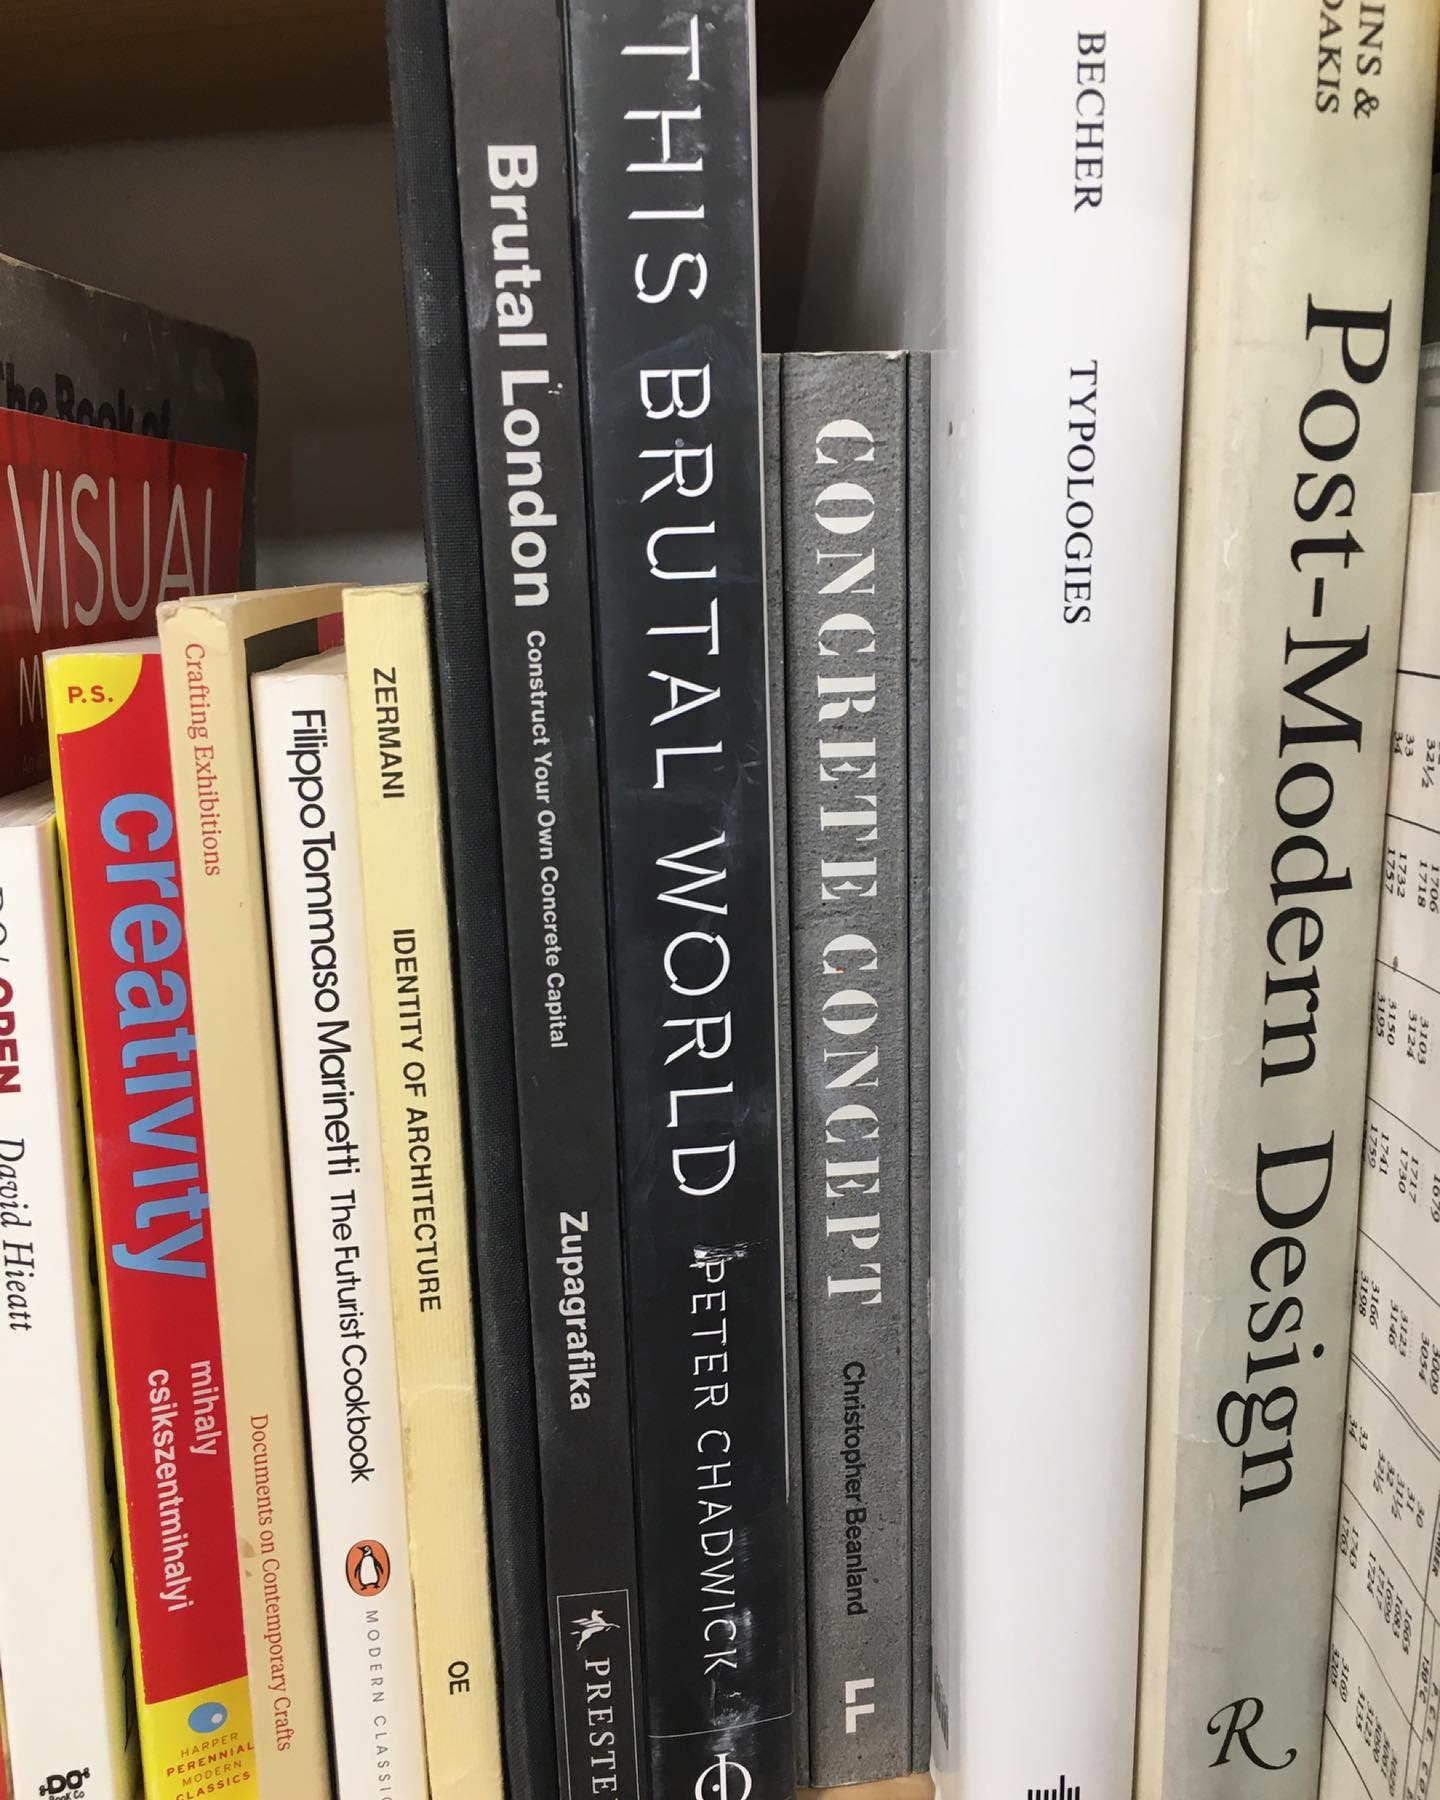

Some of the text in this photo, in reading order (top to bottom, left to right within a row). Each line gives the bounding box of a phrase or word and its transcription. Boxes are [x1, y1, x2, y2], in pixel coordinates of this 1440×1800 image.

[1354, 86, 1379, 120] &
[1063, 31, 1106, 625] BECHER TYPOLOGIES
[487, 145, 558, 607] Brutal London
[621, 14, 736, 1196] THIS BRUTAL WORLD
[68, 685, 114, 703] P.S.
[373, 667, 405, 799] ZERMANI
[1405, 734, 1415, 757] 33
[185, 643, 221, 877] Crafting Exhibitions
[526, 630, 569, 1049] Construct Your Own Concrete Capital
[815, 419, 882, 1305] CONCRETE CONCEPT
[1385, 848, 1396, 894] 1757
[1397, 852, 1407, 898] 1732
[1417, 860, 1428, 908] 1718
[1430, 864, 1440, 914] 1706
[1217, 293, 1392, 1513] Post-Modern Design
[286, 709, 360, 1176] Filippo Tommaso Marinetti
[100, 792, 210, 1279] creativity
[1375, 991, 1386, 1038] 3195
[1387, 997, 1397, 1046] 3150
[1406, 1010, 1417, 1060] 3124
[1418, 1016, 1429, 1065] 3103
[393, 928, 442, 1312] IDENTITY OF ARCHITECTURE
[1367, 1124, 1378, 1169] 1759
[1378, 1132, 1390, 1175] 1741
[1398, 1147, 1409, 1194] 1730
[1408, 1156, 1419, 1204] 1717
[0, 1138, 35, 1331] David Hieatt
[556, 1211, 597, 1411] Zupagrafika
[1358, 1271, 1369, 1317] 3198
[1369, 1280, 1380, 1329] 3166
[330, 1189, 375, 1482] The Futurist Cookbook
[1388, 1299, 1399, 1350] 3146
[1399, 1310, 1409, 1357] 3123
[1418, 1332, 1430, 1384] 3054
[190, 1359, 222, 1456] mihaly
[1359, 1426, 1369, 1450] 33
[147, 1368, 195, 1612] csikszentmihalyi
[689, 1258, 738, 1675] PETER CHADWICK
[840, 1361, 869, 1616] Christopher Beanland
[250, 1413, 292, 1751] Documents on Contemporary Crafts
[448, 1660, 470, 1695] OE
[366, 1610, 393, 1800] MODERN CLASSI
[585, 1657, 621, 1800] PRESTE
[181, 1732, 238, 1758] HARPER
[1207, 1697, 1297, 1770] R
[166, 1742, 254, 1776] PERENNIAL
[182, 1760, 242, 1787] MODERN
[176, 1771, 251, 1800] CLASSICS
